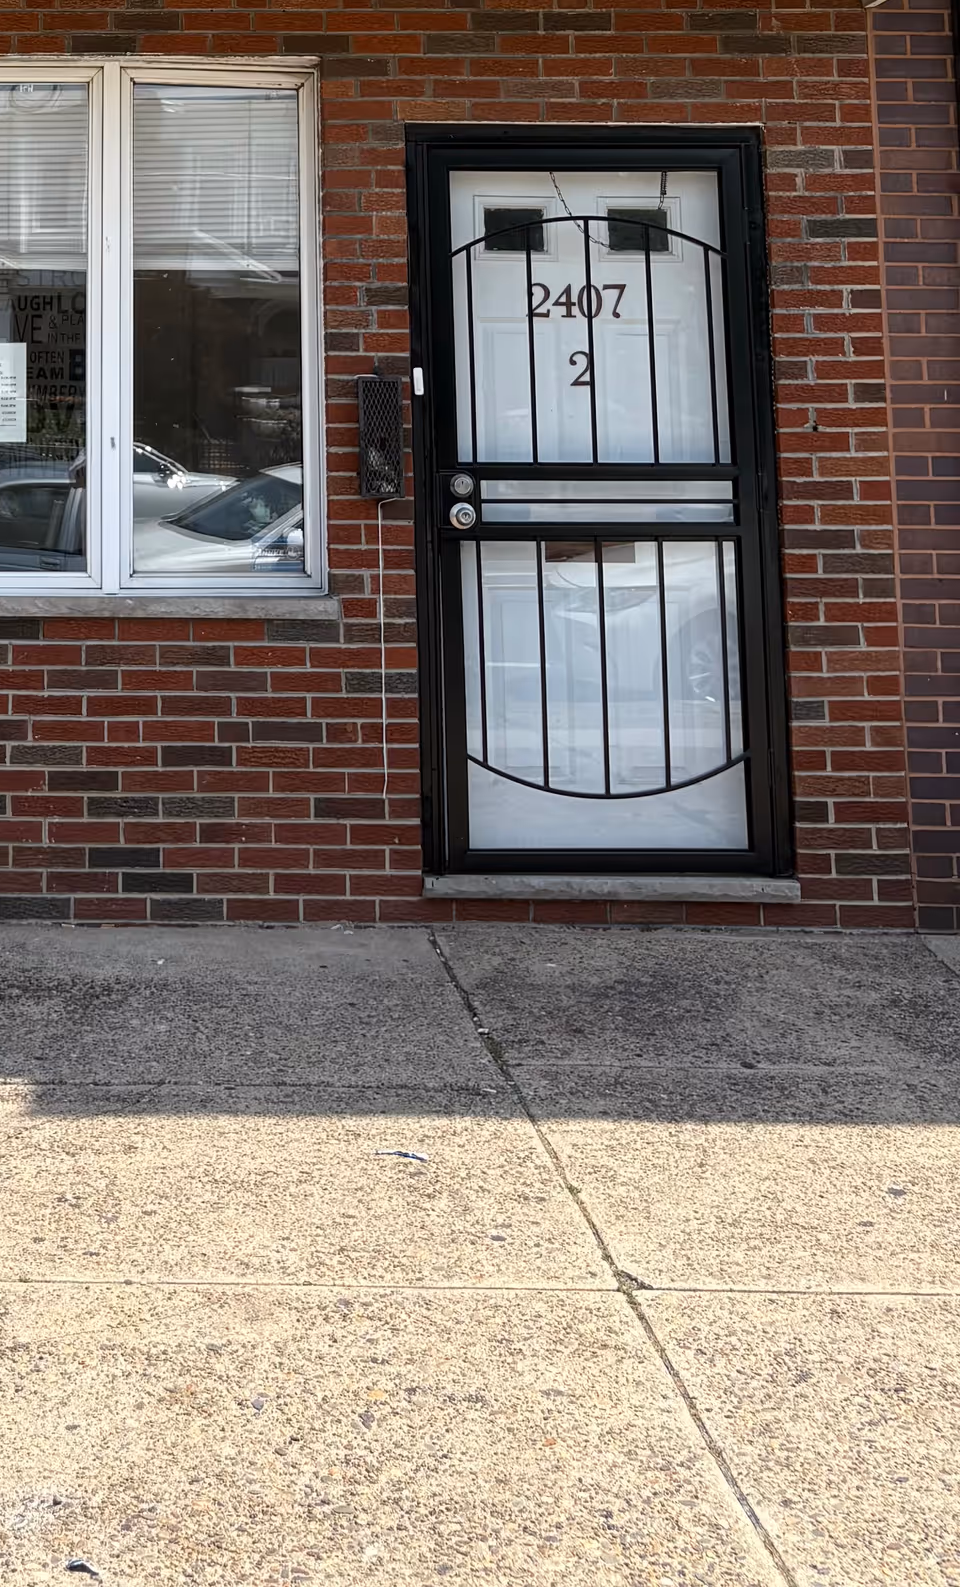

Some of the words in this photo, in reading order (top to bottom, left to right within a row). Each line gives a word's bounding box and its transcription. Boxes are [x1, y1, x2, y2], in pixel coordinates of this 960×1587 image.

[525, 282, 627, 319] 2407
[29, 351, 65, 364] OFTEN
[569, 350, 593, 387] 2
